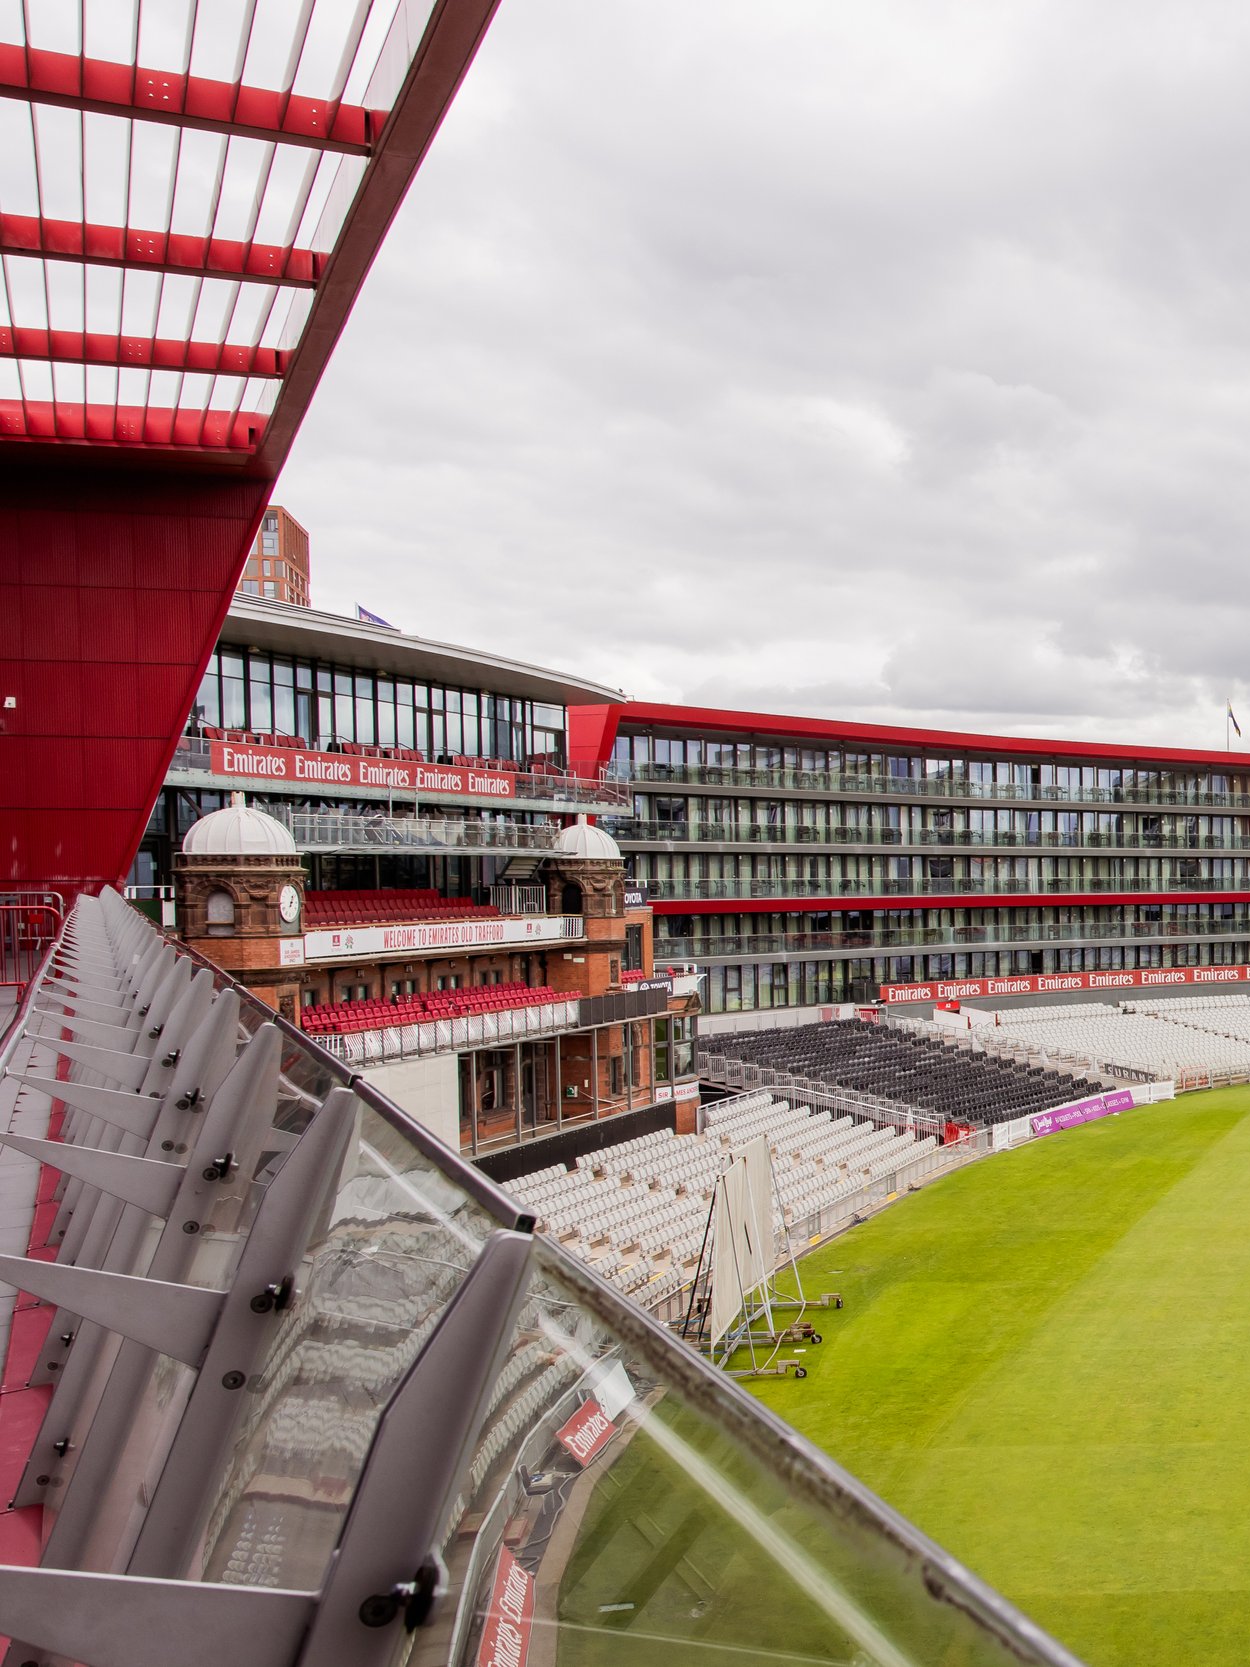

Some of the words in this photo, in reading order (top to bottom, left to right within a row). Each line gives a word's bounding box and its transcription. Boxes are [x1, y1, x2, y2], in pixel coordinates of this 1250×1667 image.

[223, 747, 286, 776] Emirates
[295, 754, 351, 781] Emirates
[359, 761, 409, 787] Emirates
[416, 767, 462, 791] Emirates
[468, 772, 510, 795] Emirates
[624, 892, 642, 904] OYOTA
[383, 928, 416, 949] WELCOME
[418, 928, 427, 946] TO
[428, 925, 460, 945] EMIRATES
[461, 924, 473, 943] OLD
[475, 923, 504, 942] TRAFFORD
[888, 986, 931, 1002] Emirates
[937, 982, 981, 998] Emirates
[987, 979, 1031, 994] Emirates
[1037, 975, 1082, 991] Emirates
[1089, 972, 1134, 987] Emirates
[1141, 969, 1186, 984] Emirates
[1193, 967, 1239, 982] Emirates
[658, 1091, 669, 1099] SIR
[565, 1410, 608, 1458] Emirates
[499, 1560, 529, 1625] Emirates
